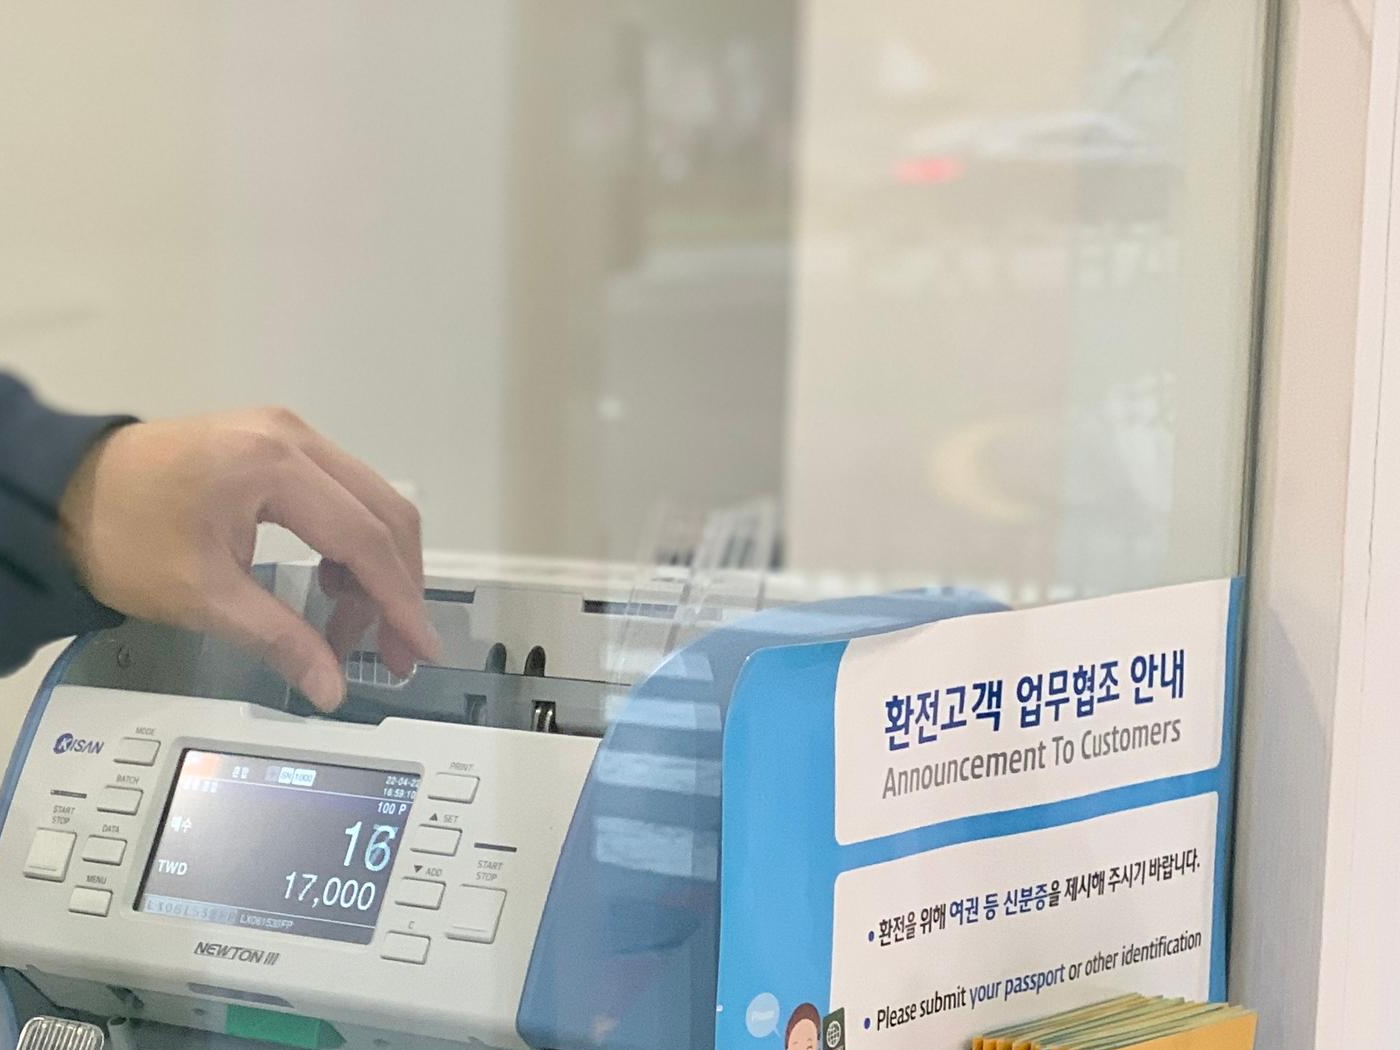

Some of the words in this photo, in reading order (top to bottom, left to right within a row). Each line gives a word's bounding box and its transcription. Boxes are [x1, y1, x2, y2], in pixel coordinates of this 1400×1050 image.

[884, 680, 1003, 751] 환전고객
[1016, 661, 1120, 728] 업무협조
[1130, 649, 1185, 705] 안내
[53, 733, 104, 755] KISAN
[882, 741, 1047, 799] Announcement
[1053, 734, 1075, 766] To
[1081, 718, 1182, 760] Customers
[116, 774, 140, 785] BATCH
[53, 805, 76, 816] START
[377, 802, 396, 815] 100
[399, 804, 407, 814] P
[52, 815, 70, 825] STOP
[157, 859, 188, 877] TWD
[477, 860, 504, 871] START
[475, 872, 498, 881] STOP
[284, 871, 376, 911] 17,000
[878, 911, 916, 947] 환전을
[920, 902, 947, 934] 위해
[949, 896, 980, 926] 여권
[983, 893, 1000, 921] 등
[1003, 879, 1062, 916] 신분증을
[1064, 868, 1105, 901] 제시해
[1108, 861, 1147, 893] 주시기
[1149, 848, 1201, 882] 바랍니다.
[194, 941, 265, 964] NEWTON
[876, 1000, 917, 1031] Please
[919, 985, 967, 1021] submit
[969, 979, 1002, 1011] your
[1003, 963, 1066, 1001] passport
[1068, 964, 1083, 982] or
[1084, 950, 1119, 976] other
[1121, 930, 1202, 967] identification
